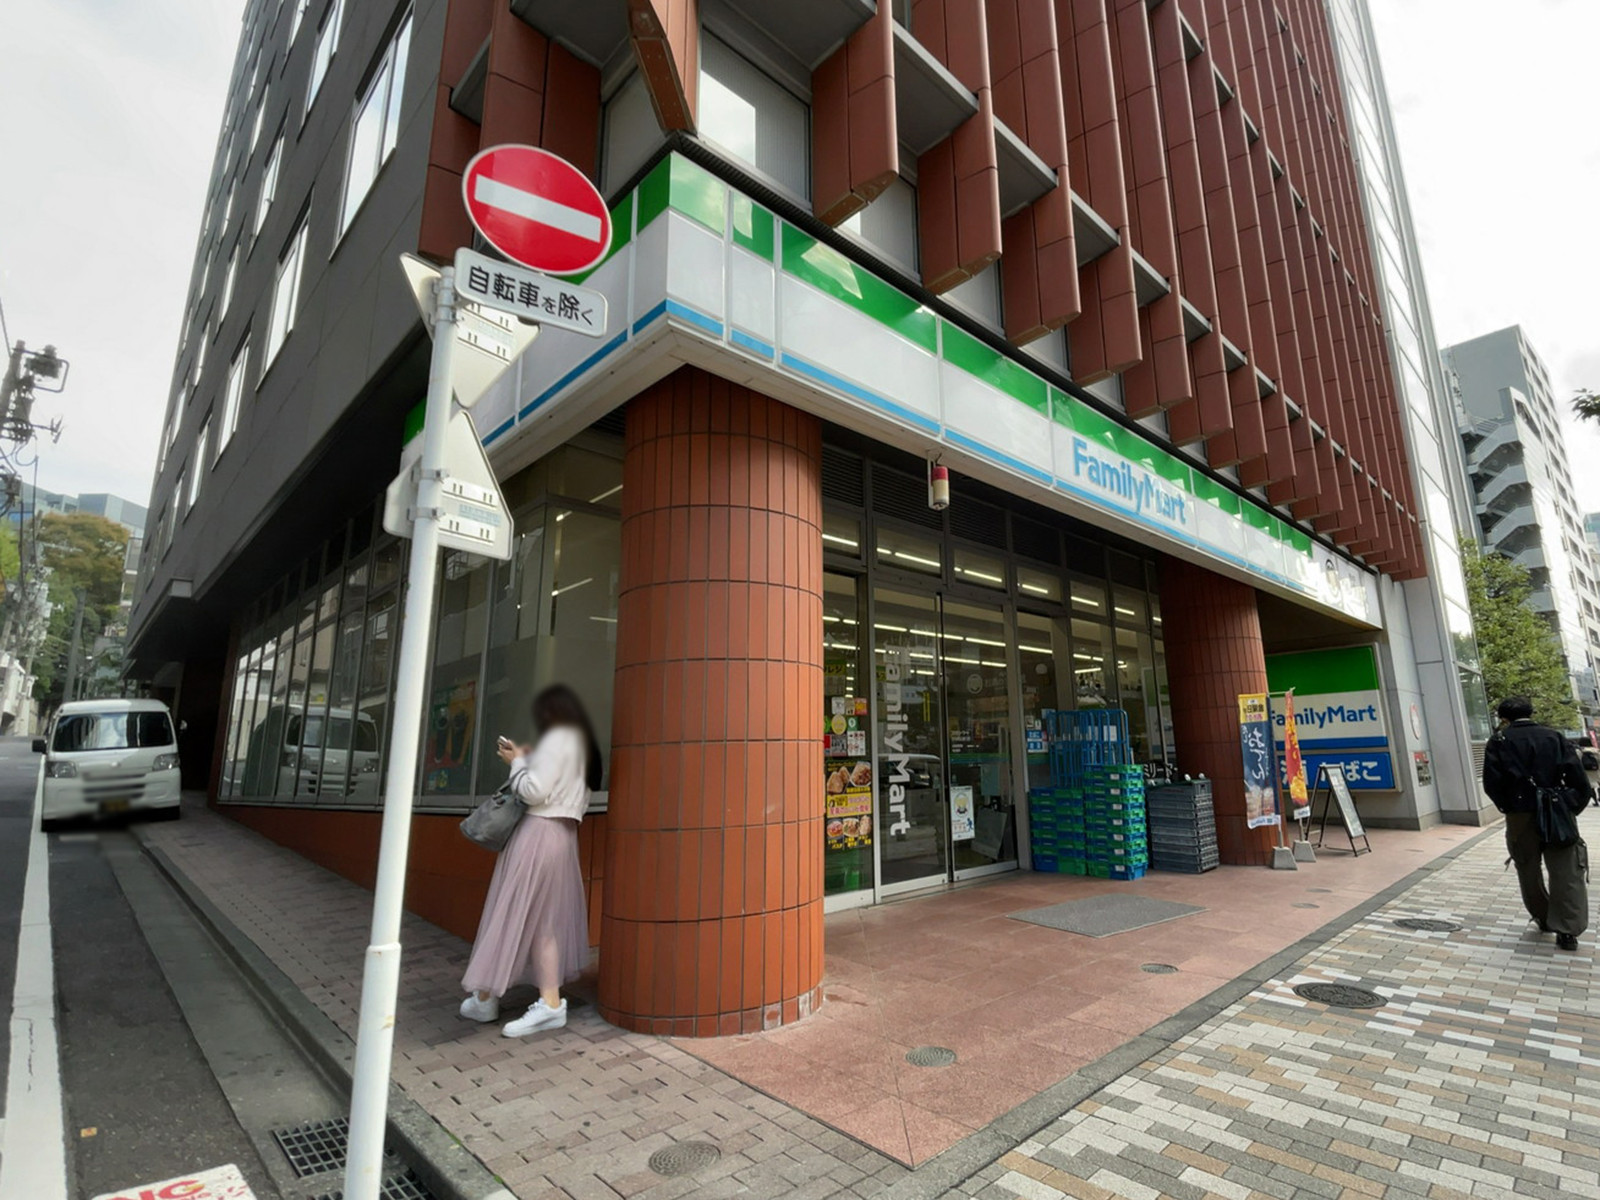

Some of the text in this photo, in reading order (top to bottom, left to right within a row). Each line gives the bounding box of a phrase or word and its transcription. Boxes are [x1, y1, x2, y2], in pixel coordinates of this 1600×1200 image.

[468, 265, 593, 326] 自転車を除く
[1072, 435, 1186, 525] FamilyMart
